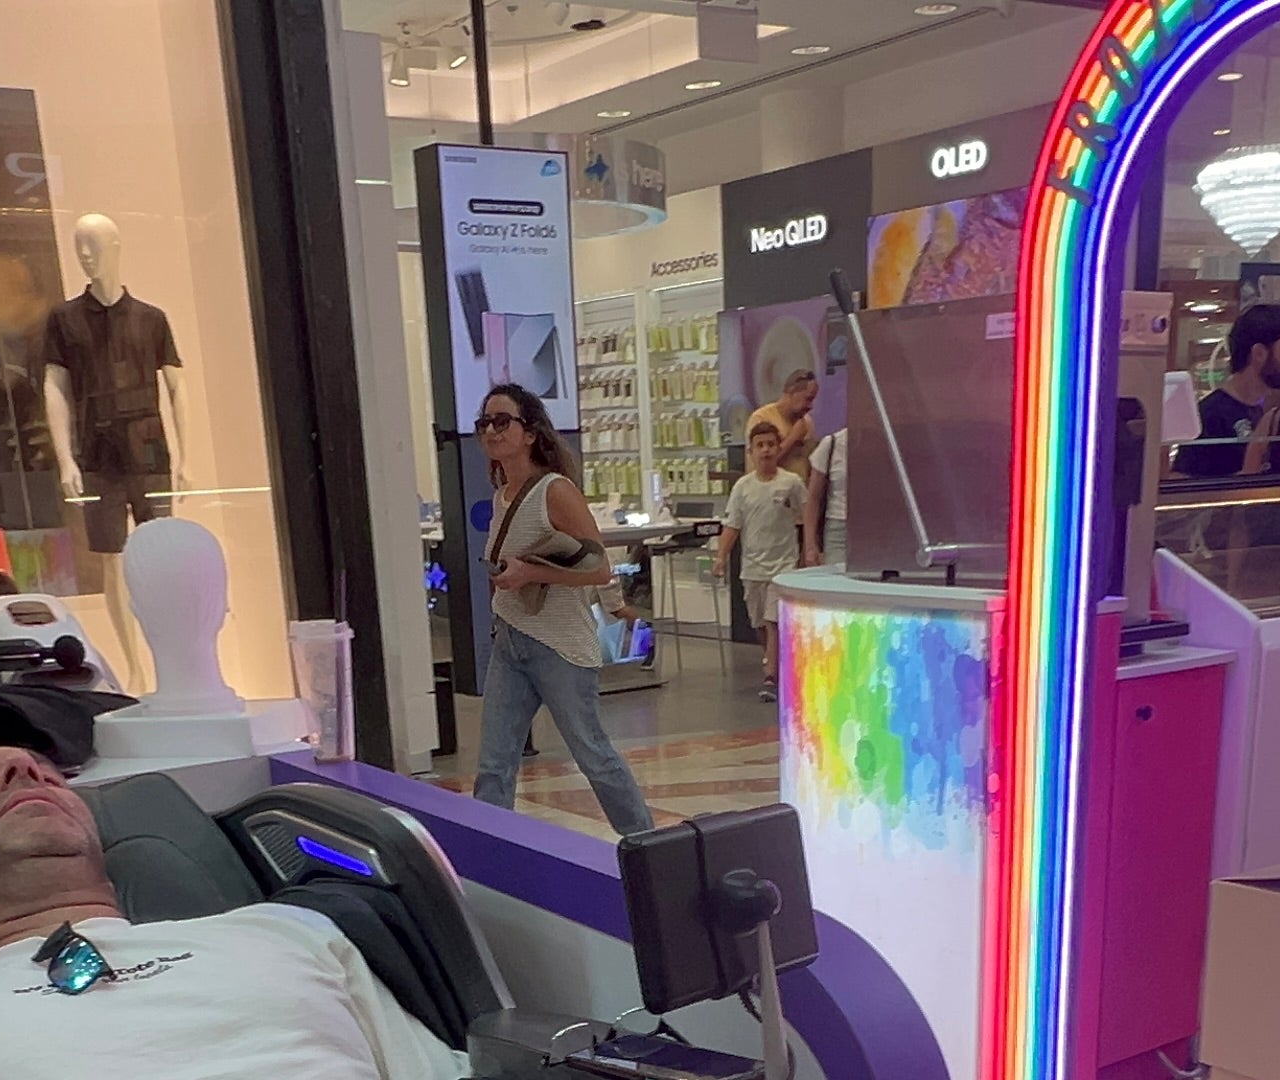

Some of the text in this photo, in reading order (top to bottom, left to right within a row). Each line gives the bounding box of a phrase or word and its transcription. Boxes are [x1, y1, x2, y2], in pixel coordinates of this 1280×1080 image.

[930, 140, 989, 179] OLED
[457, 221, 558, 241] Galaxy Z Fold6
[750, 214, 828, 254] Neo QLED
[649, 251, 720, 278] Accessories
